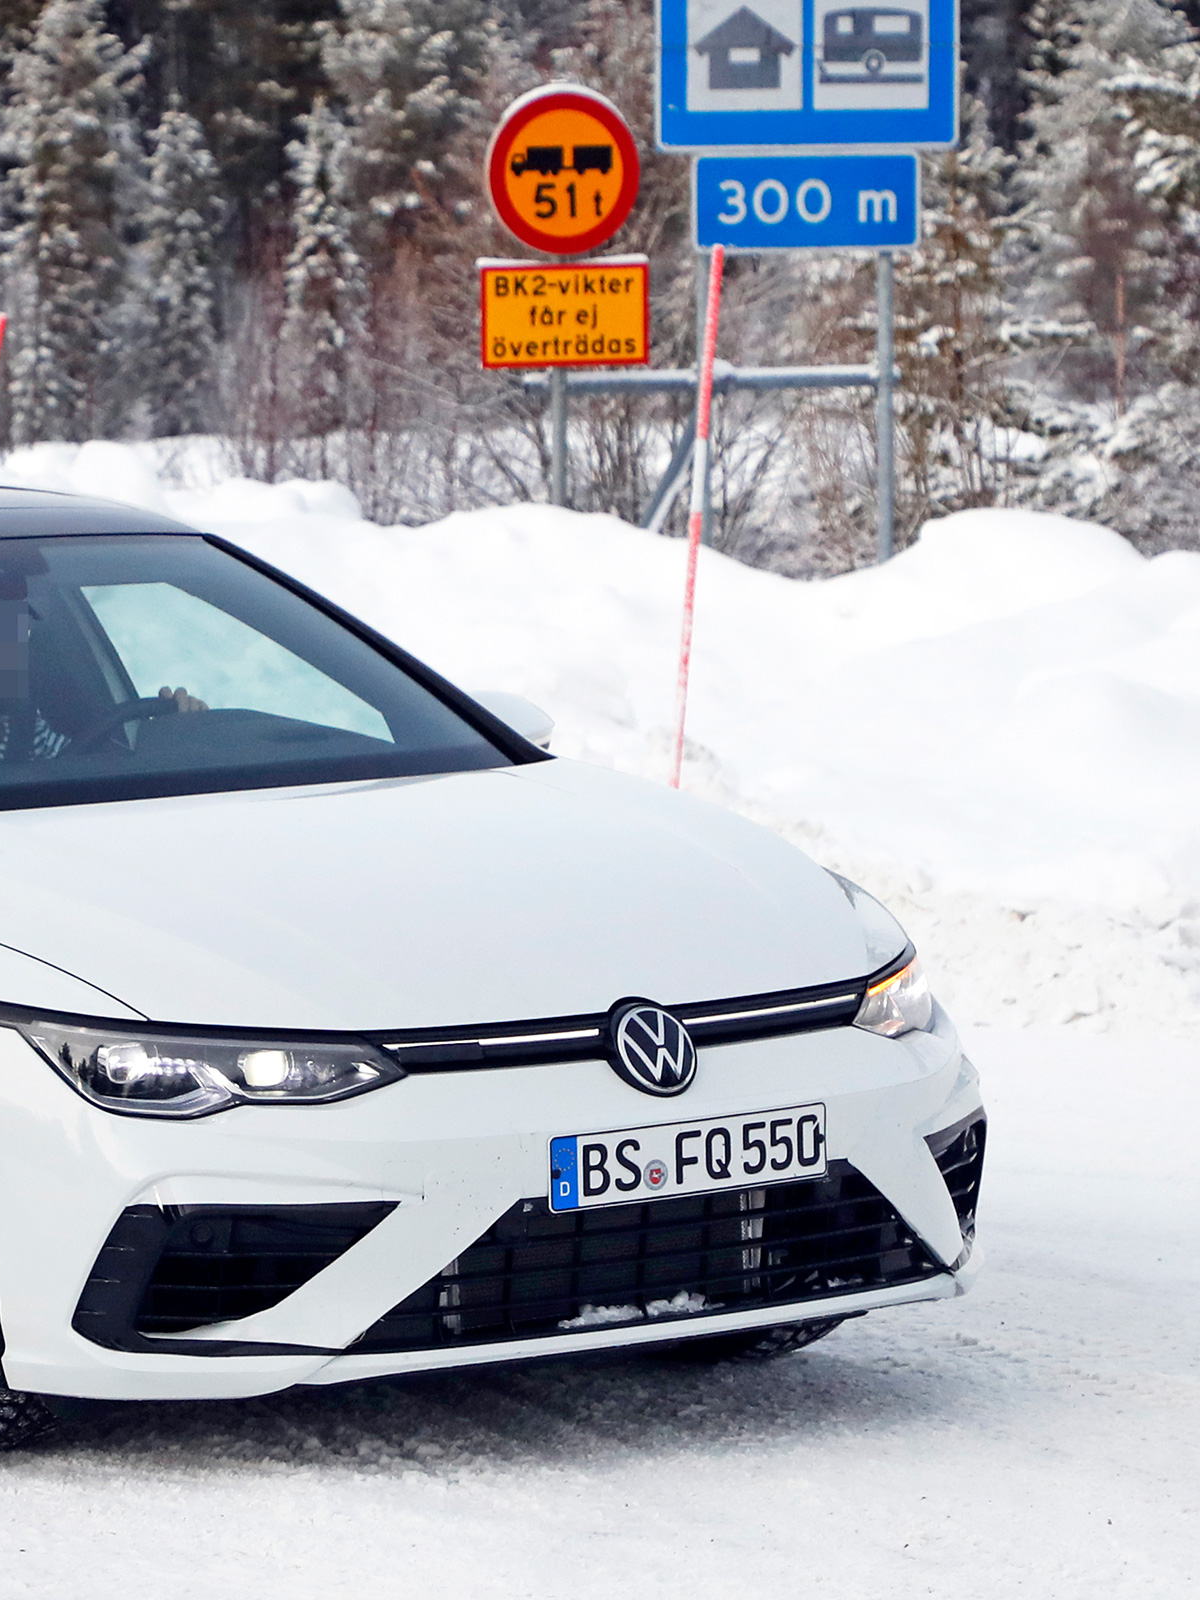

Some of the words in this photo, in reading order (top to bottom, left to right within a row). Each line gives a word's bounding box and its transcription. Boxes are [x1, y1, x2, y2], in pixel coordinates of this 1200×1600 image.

[534, 183, 577, 218] 51
[594, 190, 603, 217] t
[717, 178, 832, 224] 300
[857, 189, 898, 223] m
[494, 274, 635, 297] BK2-vikter
[530, 306, 566, 325] får
[576, 305, 598, 329] ej
[492, 334, 637, 358] överträdas
[582, 1139, 642, 1197] BS
[675, 1127, 731, 1185] FQ
[742, 1114, 820, 1175] 550
[559, 1181, 570, 1197] D
